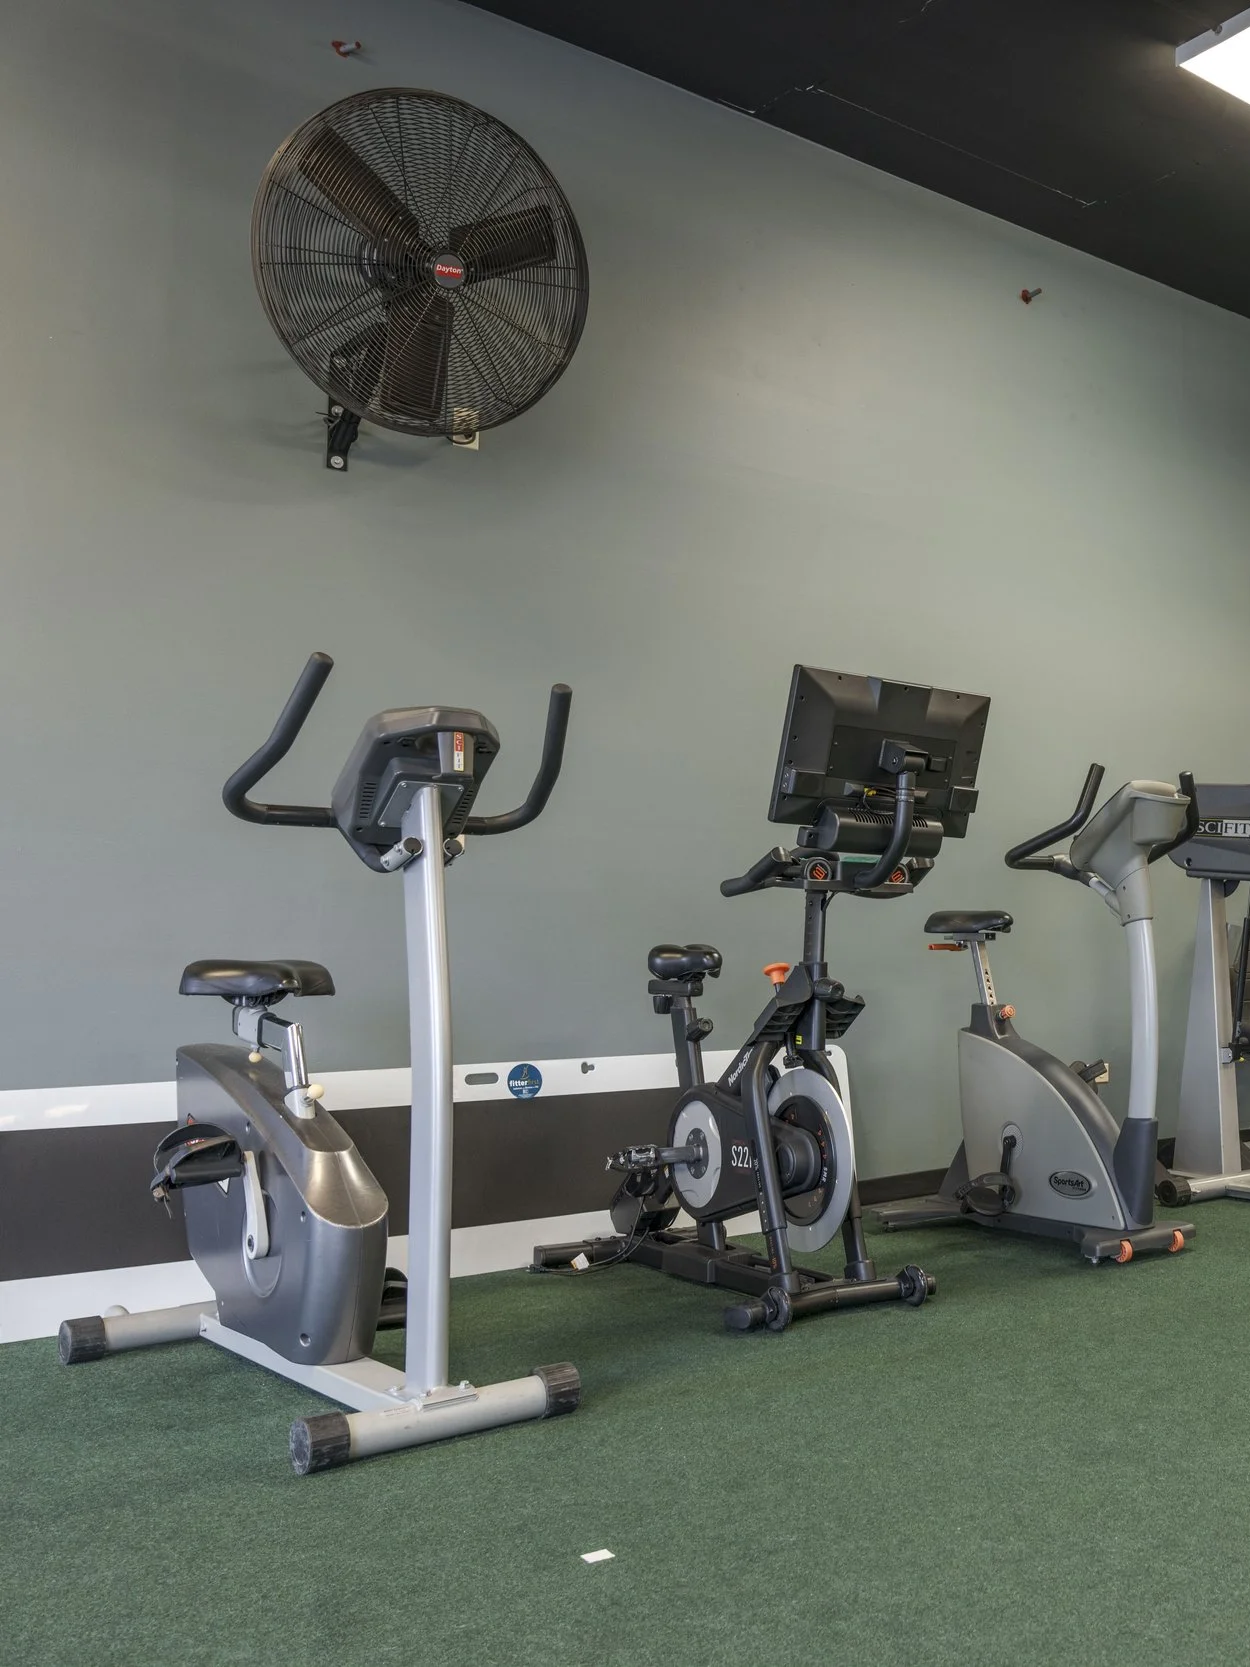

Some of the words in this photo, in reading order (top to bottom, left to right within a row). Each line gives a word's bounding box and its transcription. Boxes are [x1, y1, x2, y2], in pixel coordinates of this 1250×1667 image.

[436, 264, 462, 274] Dayton
[1197, 821, 1250, 834] SCIFIT
[728, 1046, 755, 1087] NordicTr
[1053, 1176, 1084, 1188] SportsArt
